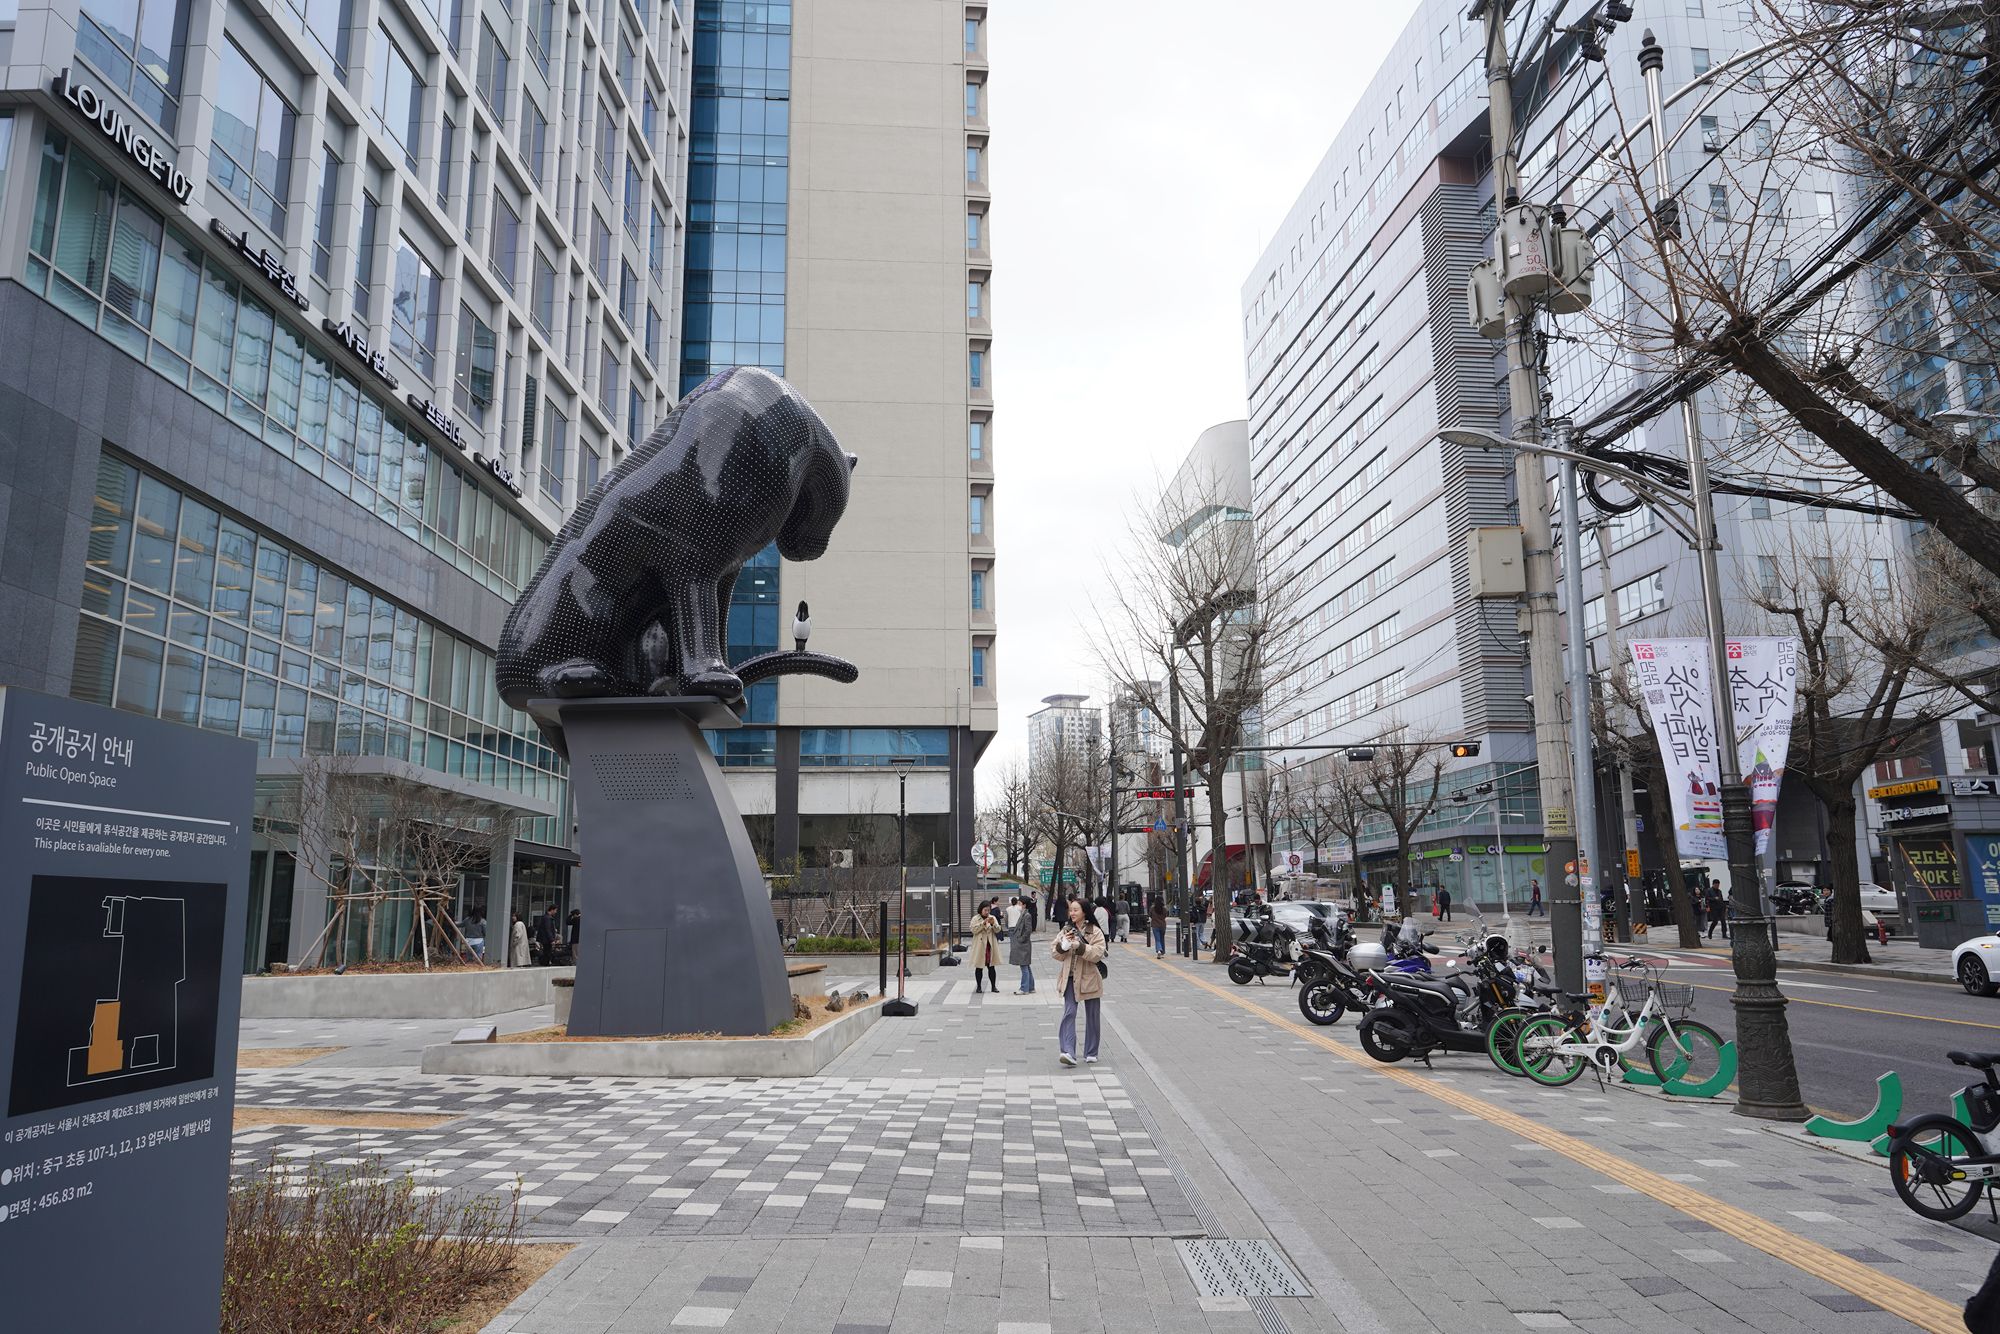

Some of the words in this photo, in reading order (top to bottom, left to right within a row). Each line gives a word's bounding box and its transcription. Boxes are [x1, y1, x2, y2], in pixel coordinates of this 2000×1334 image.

[62, 68, 196, 205] LOUNGE107
[242, 231, 298, 301] 느루집
[337, 321, 388, 379] 사리원
[29, 721, 98, 762] 공개공지
[102, 736, 134, 768] 안내
[25, 761, 58, 779] Public
[60, 767, 87, 785] Open
[89, 771, 117, 788] Space
[1952, 778, 2000, 796] 헬스
[34, 837, 52, 849] This
[54, 838, 77, 852] place
[78, 840, 85, 851] is
[122, 842, 134, 855] for
[134, 846, 155, 859] every
[155, 847, 171, 858] one.
[36, 817, 61, 831] 이곳은
[63, 820, 102, 835] 시민들에게
[103, 823, 139, 839] 휴식공간을
[140, 826, 168, 841] 제공하는
[169, 830, 195, 844] 공개공지
[196, 833, 228, 846] 공간입니다.
[1487, 845, 1504, 855] CU
[4, 1130, 14, 1144] 이
[15, 1121, 56, 1142] 공개공지는
[57, 1115, 80, 1132] 서울시
[81, 1109, 111, 1129] 건축조례
[111, 1104, 134, 1121] 제26조
[135, 1100, 152, 1115] 1항에
[152, 1094, 177, 1111] 의거하여
[178, 1089, 207, 1106] 일반인에게
[207, 1086, 219, 1099] 공개
[12, 1160, 34, 1183] 위치
[42, 1154, 63, 1176] 중구
[65, 1149, 85, 1169] 초동
[87, 1141, 118, 1164] 107-1,
[119, 1138, 134, 1155] 12,
[135, 1135, 147, 1151] 13
[148, 1126, 181, 1148] 업무시설
[181, 1117, 212, 1138] 개발사업
[9, 1197, 31, 1220] 면적
[38, 1186, 75, 1209] 456.83
[76, 1181, 94, 1199] m2
